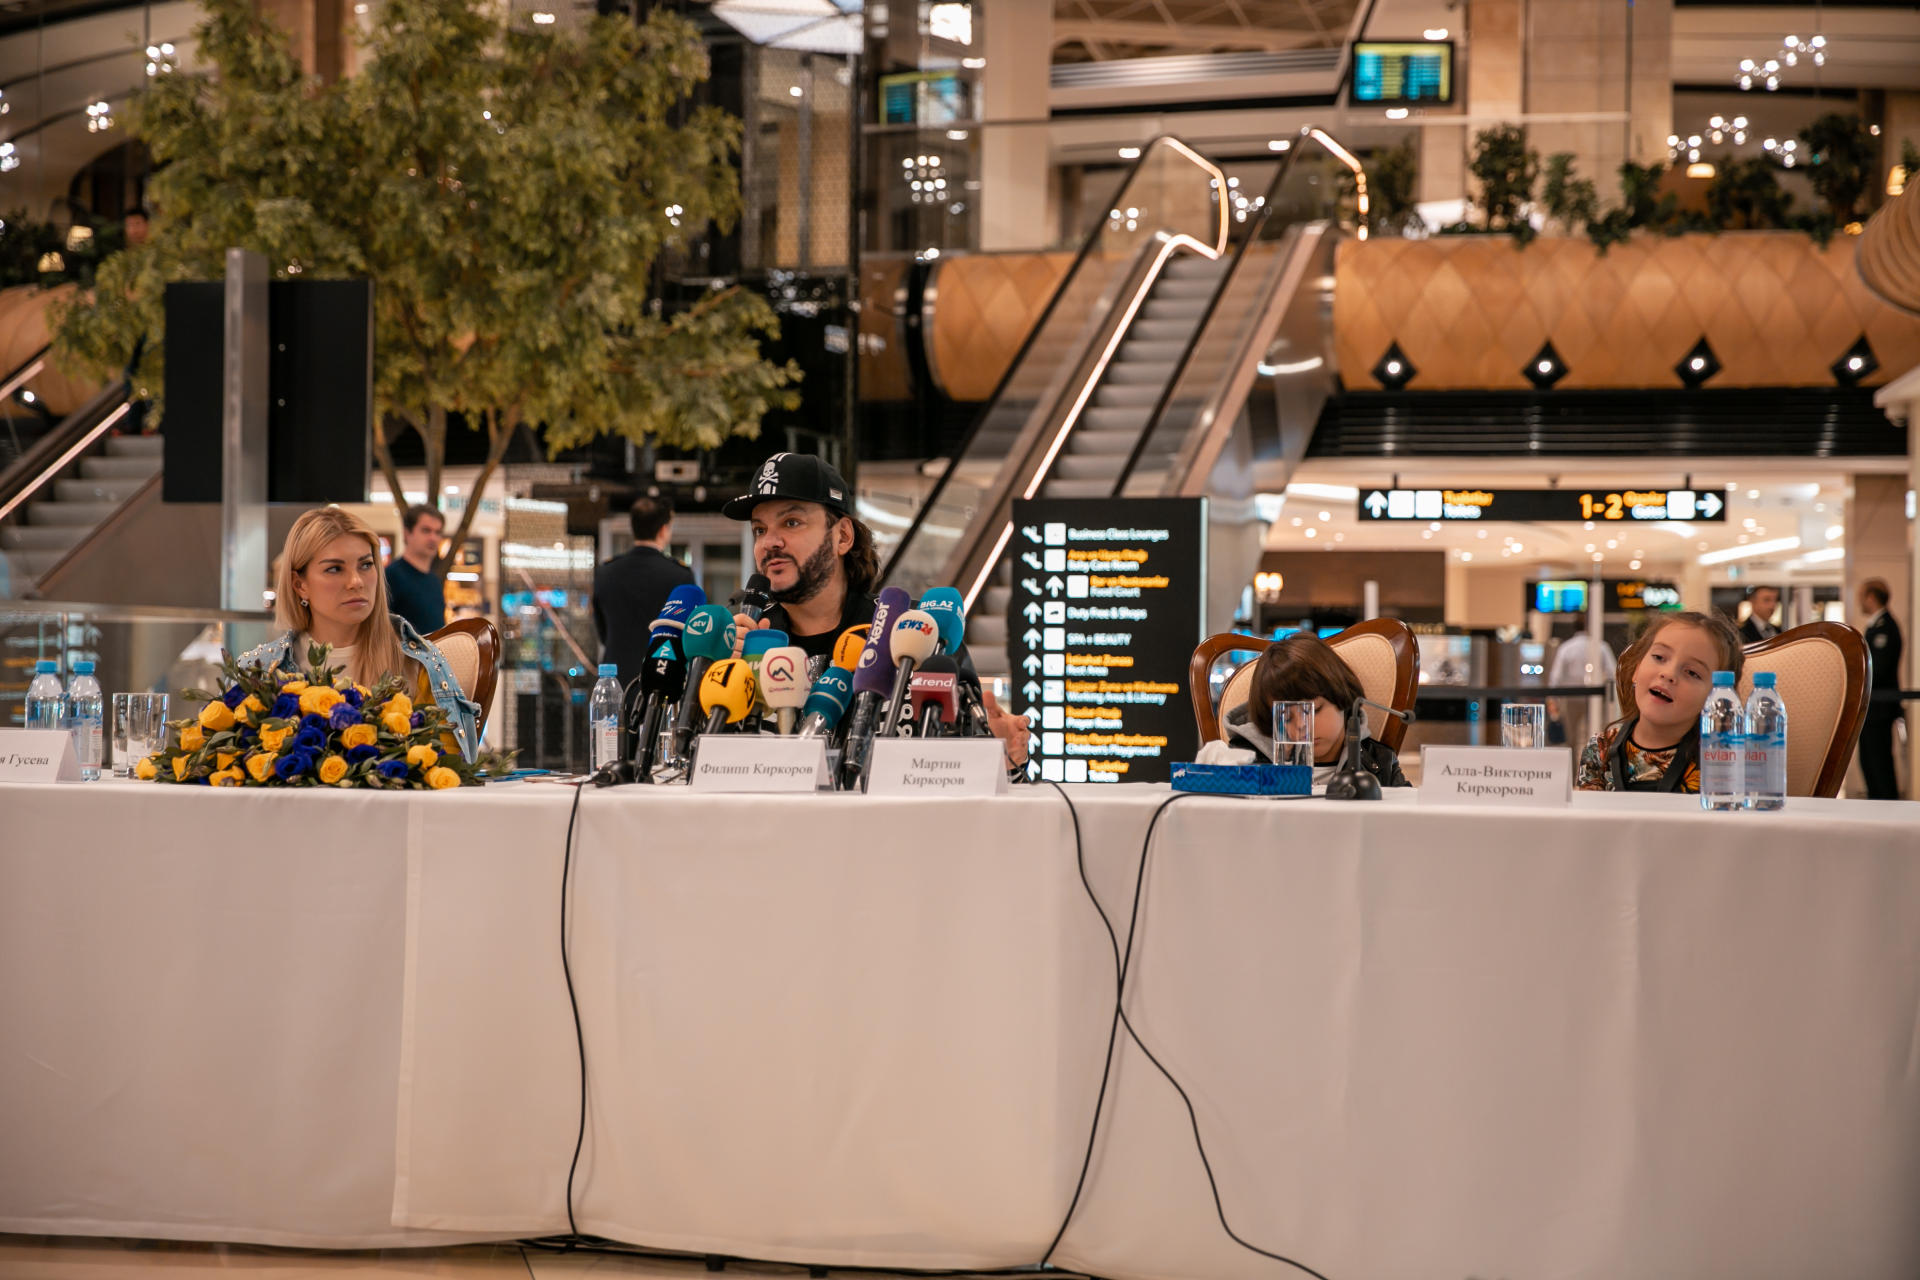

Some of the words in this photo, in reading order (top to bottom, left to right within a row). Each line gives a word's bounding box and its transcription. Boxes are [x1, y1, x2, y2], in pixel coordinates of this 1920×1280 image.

[1579, 493, 1623, 520] 1-2
[9, 754, 49, 767] Гусева
[1704, 750, 1737, 761] evian
[700, 763, 749, 775] Филипп
[753, 763, 813, 776] Киркоров
[911, 758, 961, 771] Мартин
[1441, 763, 1553, 782] Алла-Виктория
[903, 774, 965, 787] Киркоров
[1457, 782, 1534, 797] Киркорова
